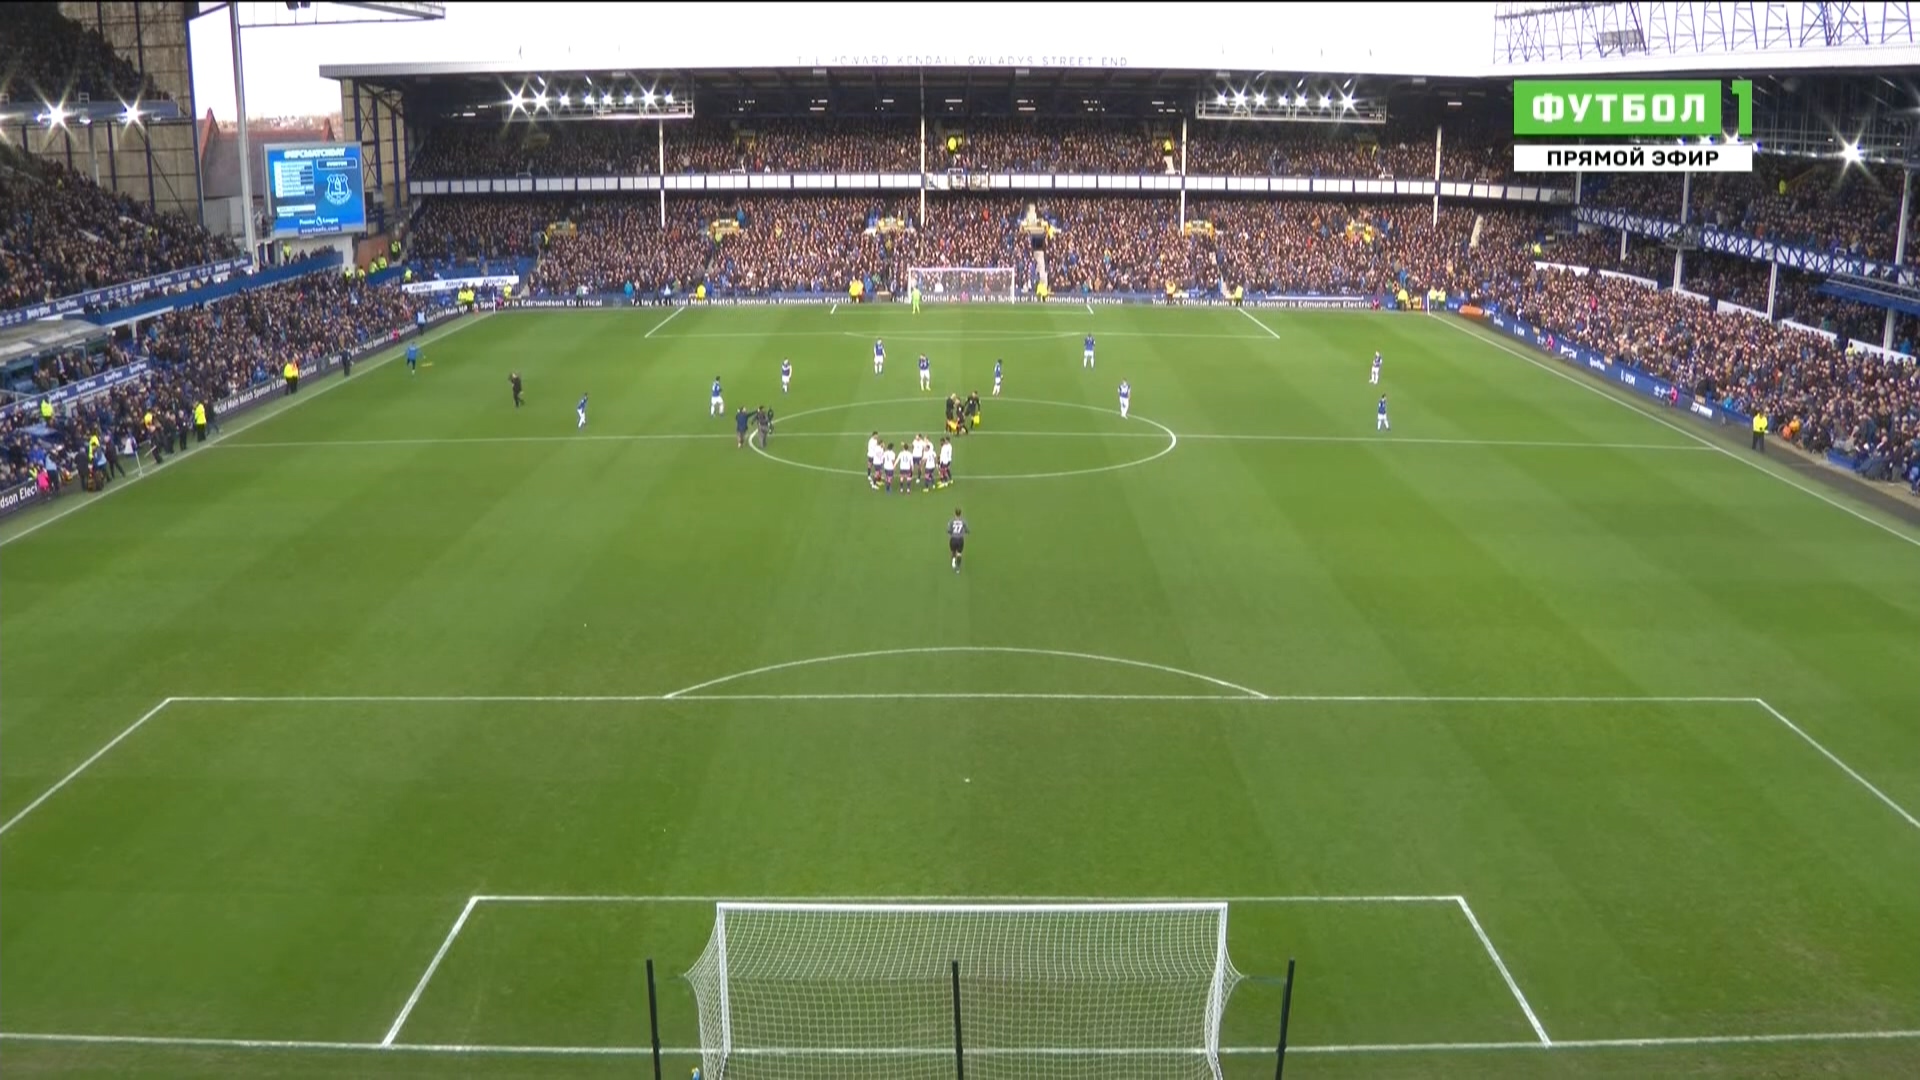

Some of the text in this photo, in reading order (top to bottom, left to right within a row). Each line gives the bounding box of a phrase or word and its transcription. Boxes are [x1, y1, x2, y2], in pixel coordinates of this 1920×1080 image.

[797, 56, 821, 66] TE
[968, 55, 1034, 66] GWLADYS
[1042, 56, 1094, 66] STREET
[1101, 56, 1128, 67] END
[521, 299, 565, 307] Edmundson
[711, 298, 734, 306] Match
[736, 298, 768, 307] Sponsor
[921, 294, 949, 303] Official
[1086, 296, 1123, 304] Electrical
[1182, 298, 1209, 306] Official
[1211, 298, 1230, 306] Main
[1257, 299, 1288, 308] Sponsor
[952, 524, 964, 534] 27
